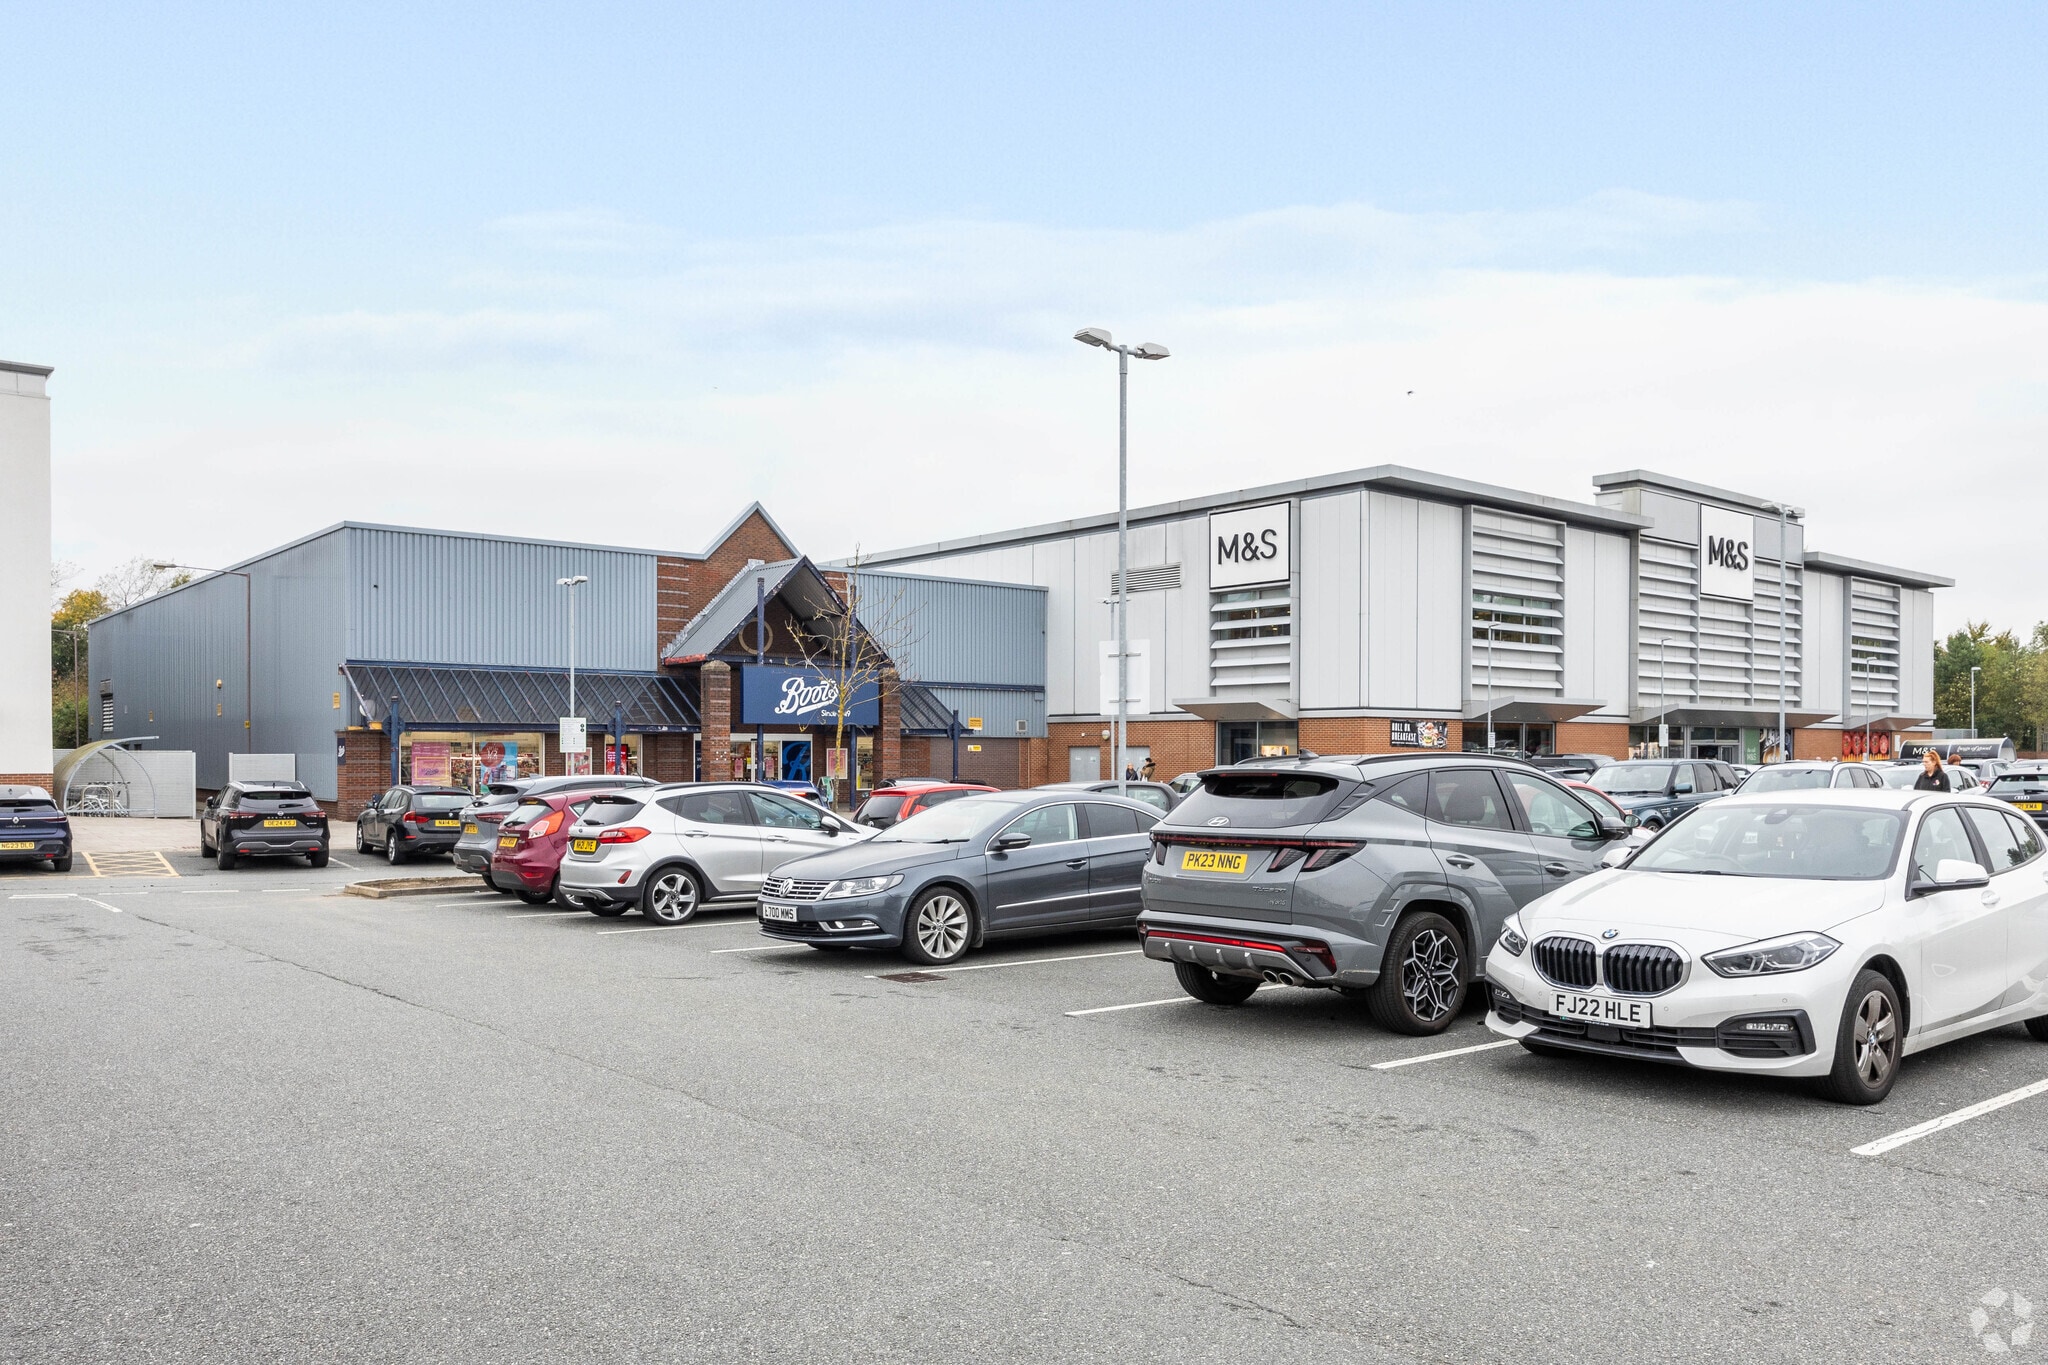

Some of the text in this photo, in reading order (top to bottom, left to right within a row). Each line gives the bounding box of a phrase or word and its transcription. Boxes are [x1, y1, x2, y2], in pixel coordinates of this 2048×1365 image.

[1217, 528, 1277, 565] M&S
[1708, 535, 1748, 571] M&S
[774, 676, 839, 716] Boots
[1391, 731, 1417, 742] BREAKFAST
[1186, 853, 1242, 869] PK23 NNG
[780, 907, 794, 920] MMS
[1556, 994, 1641, 1023] FJ22 HLE
